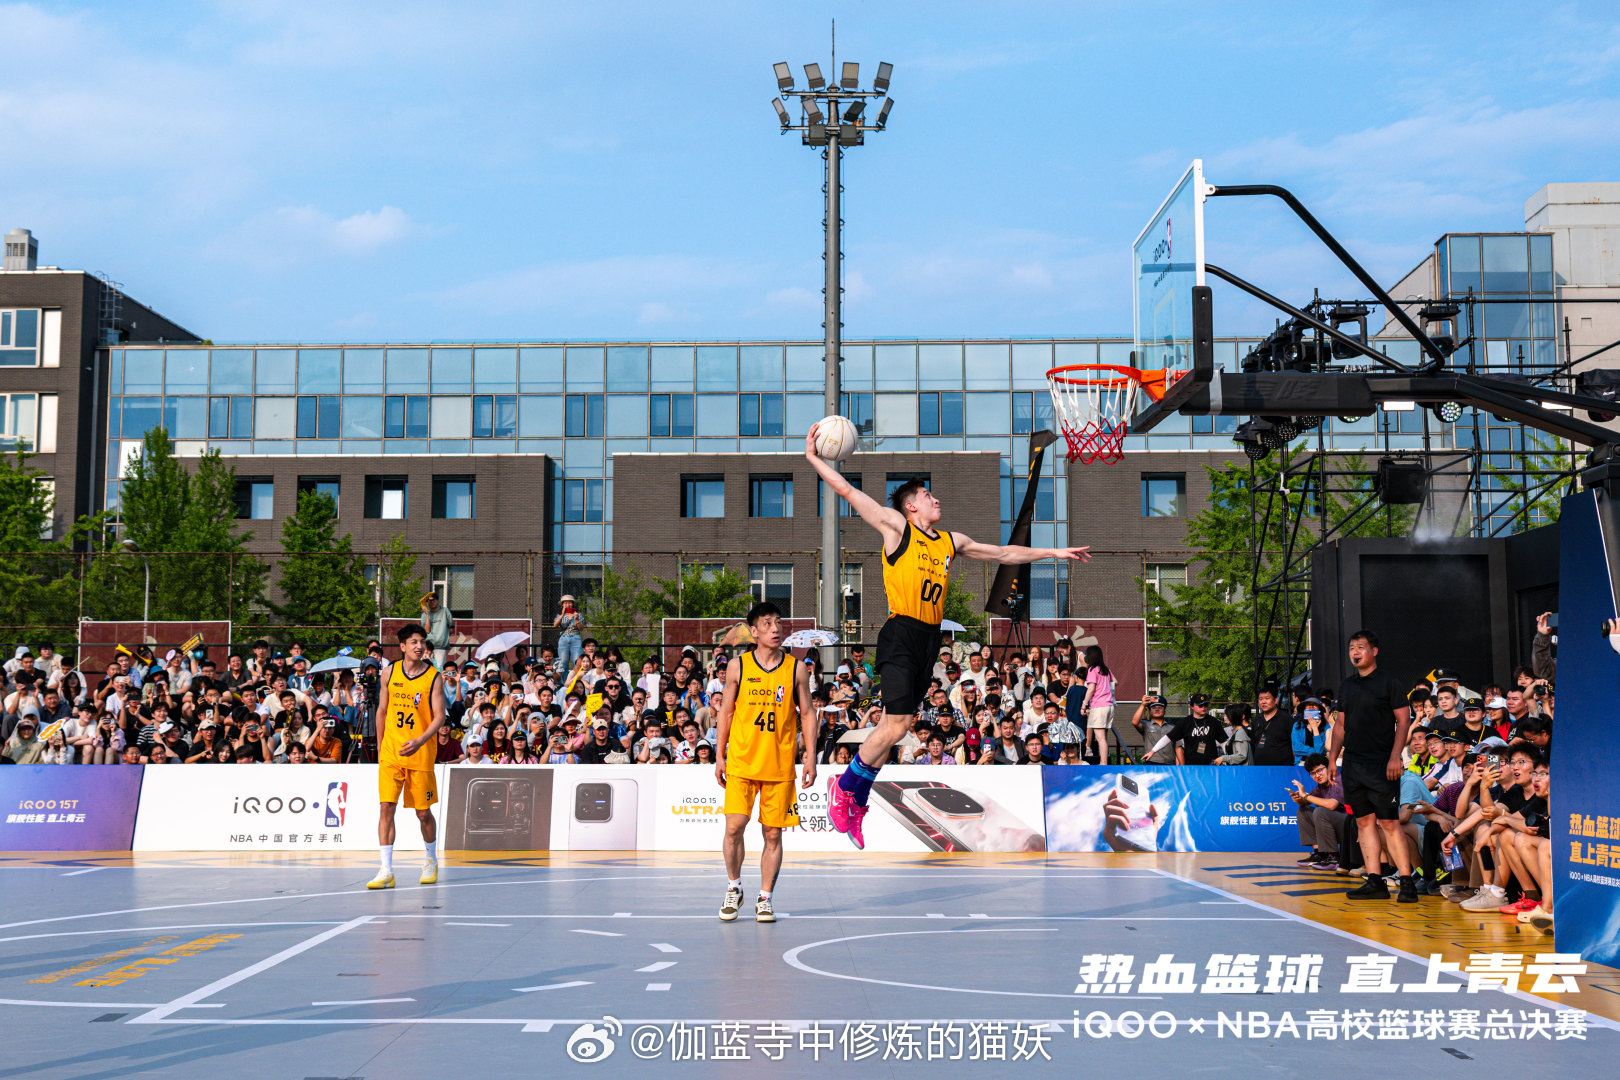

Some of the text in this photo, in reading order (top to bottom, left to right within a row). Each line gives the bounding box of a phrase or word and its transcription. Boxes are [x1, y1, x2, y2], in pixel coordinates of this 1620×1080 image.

[920, 578, 943, 605] 00
[396, 711, 415, 729] 34
[753, 711, 776, 732] 48
[19, 800, 79, 810] iQOO 15T
[233, 796, 307, 814] iQOO
[671, 805, 725, 815] ULTRA
[1229, 802, 1287, 812] iQOO 15T
[1220, 815, 1298, 825] 旗舰性能 直上青云
[1569, 813, 1620, 840] 热血篮球
[229, 833, 342, 843] NBA 中国官方手机
[1569, 841, 1620, 869] 直上青云
